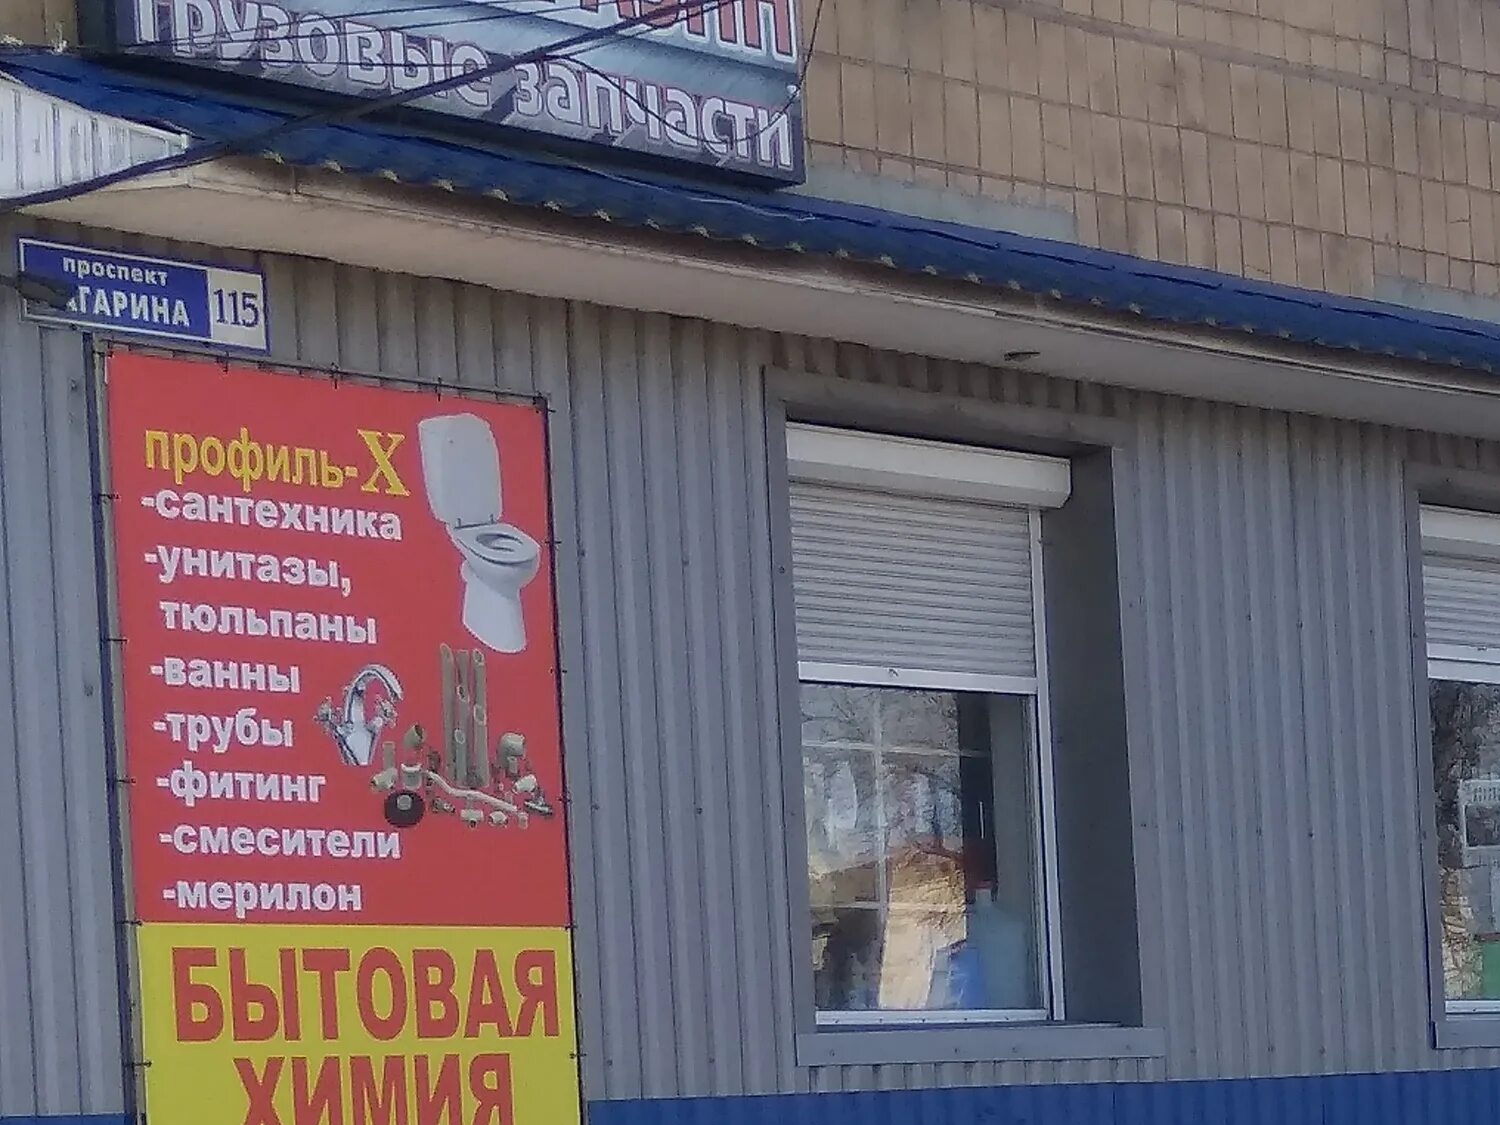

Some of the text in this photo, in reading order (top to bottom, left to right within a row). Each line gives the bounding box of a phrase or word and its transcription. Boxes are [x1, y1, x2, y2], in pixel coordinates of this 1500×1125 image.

[513, 56, 794, 172] запчасти
[62, 256, 169, 287] проспект
[213, 288, 262, 328] 115
[145, 427, 411, 497] профиль-Х
[141, 490, 402, 540] -сантехника
[144, 544, 352, 597] -унитазы,
[159, 600, 378, 645] тюльпаны
[151, 656, 300, 693] -ванны
[154, 708, 294, 753] -трубы
[156, 760, 326, 805] -фитинг
[159, 824, 402, 859] -смесители
[163, 878, 363, 918] -мерилон
[171, 946, 561, 1042] БЫТОВАЯ
